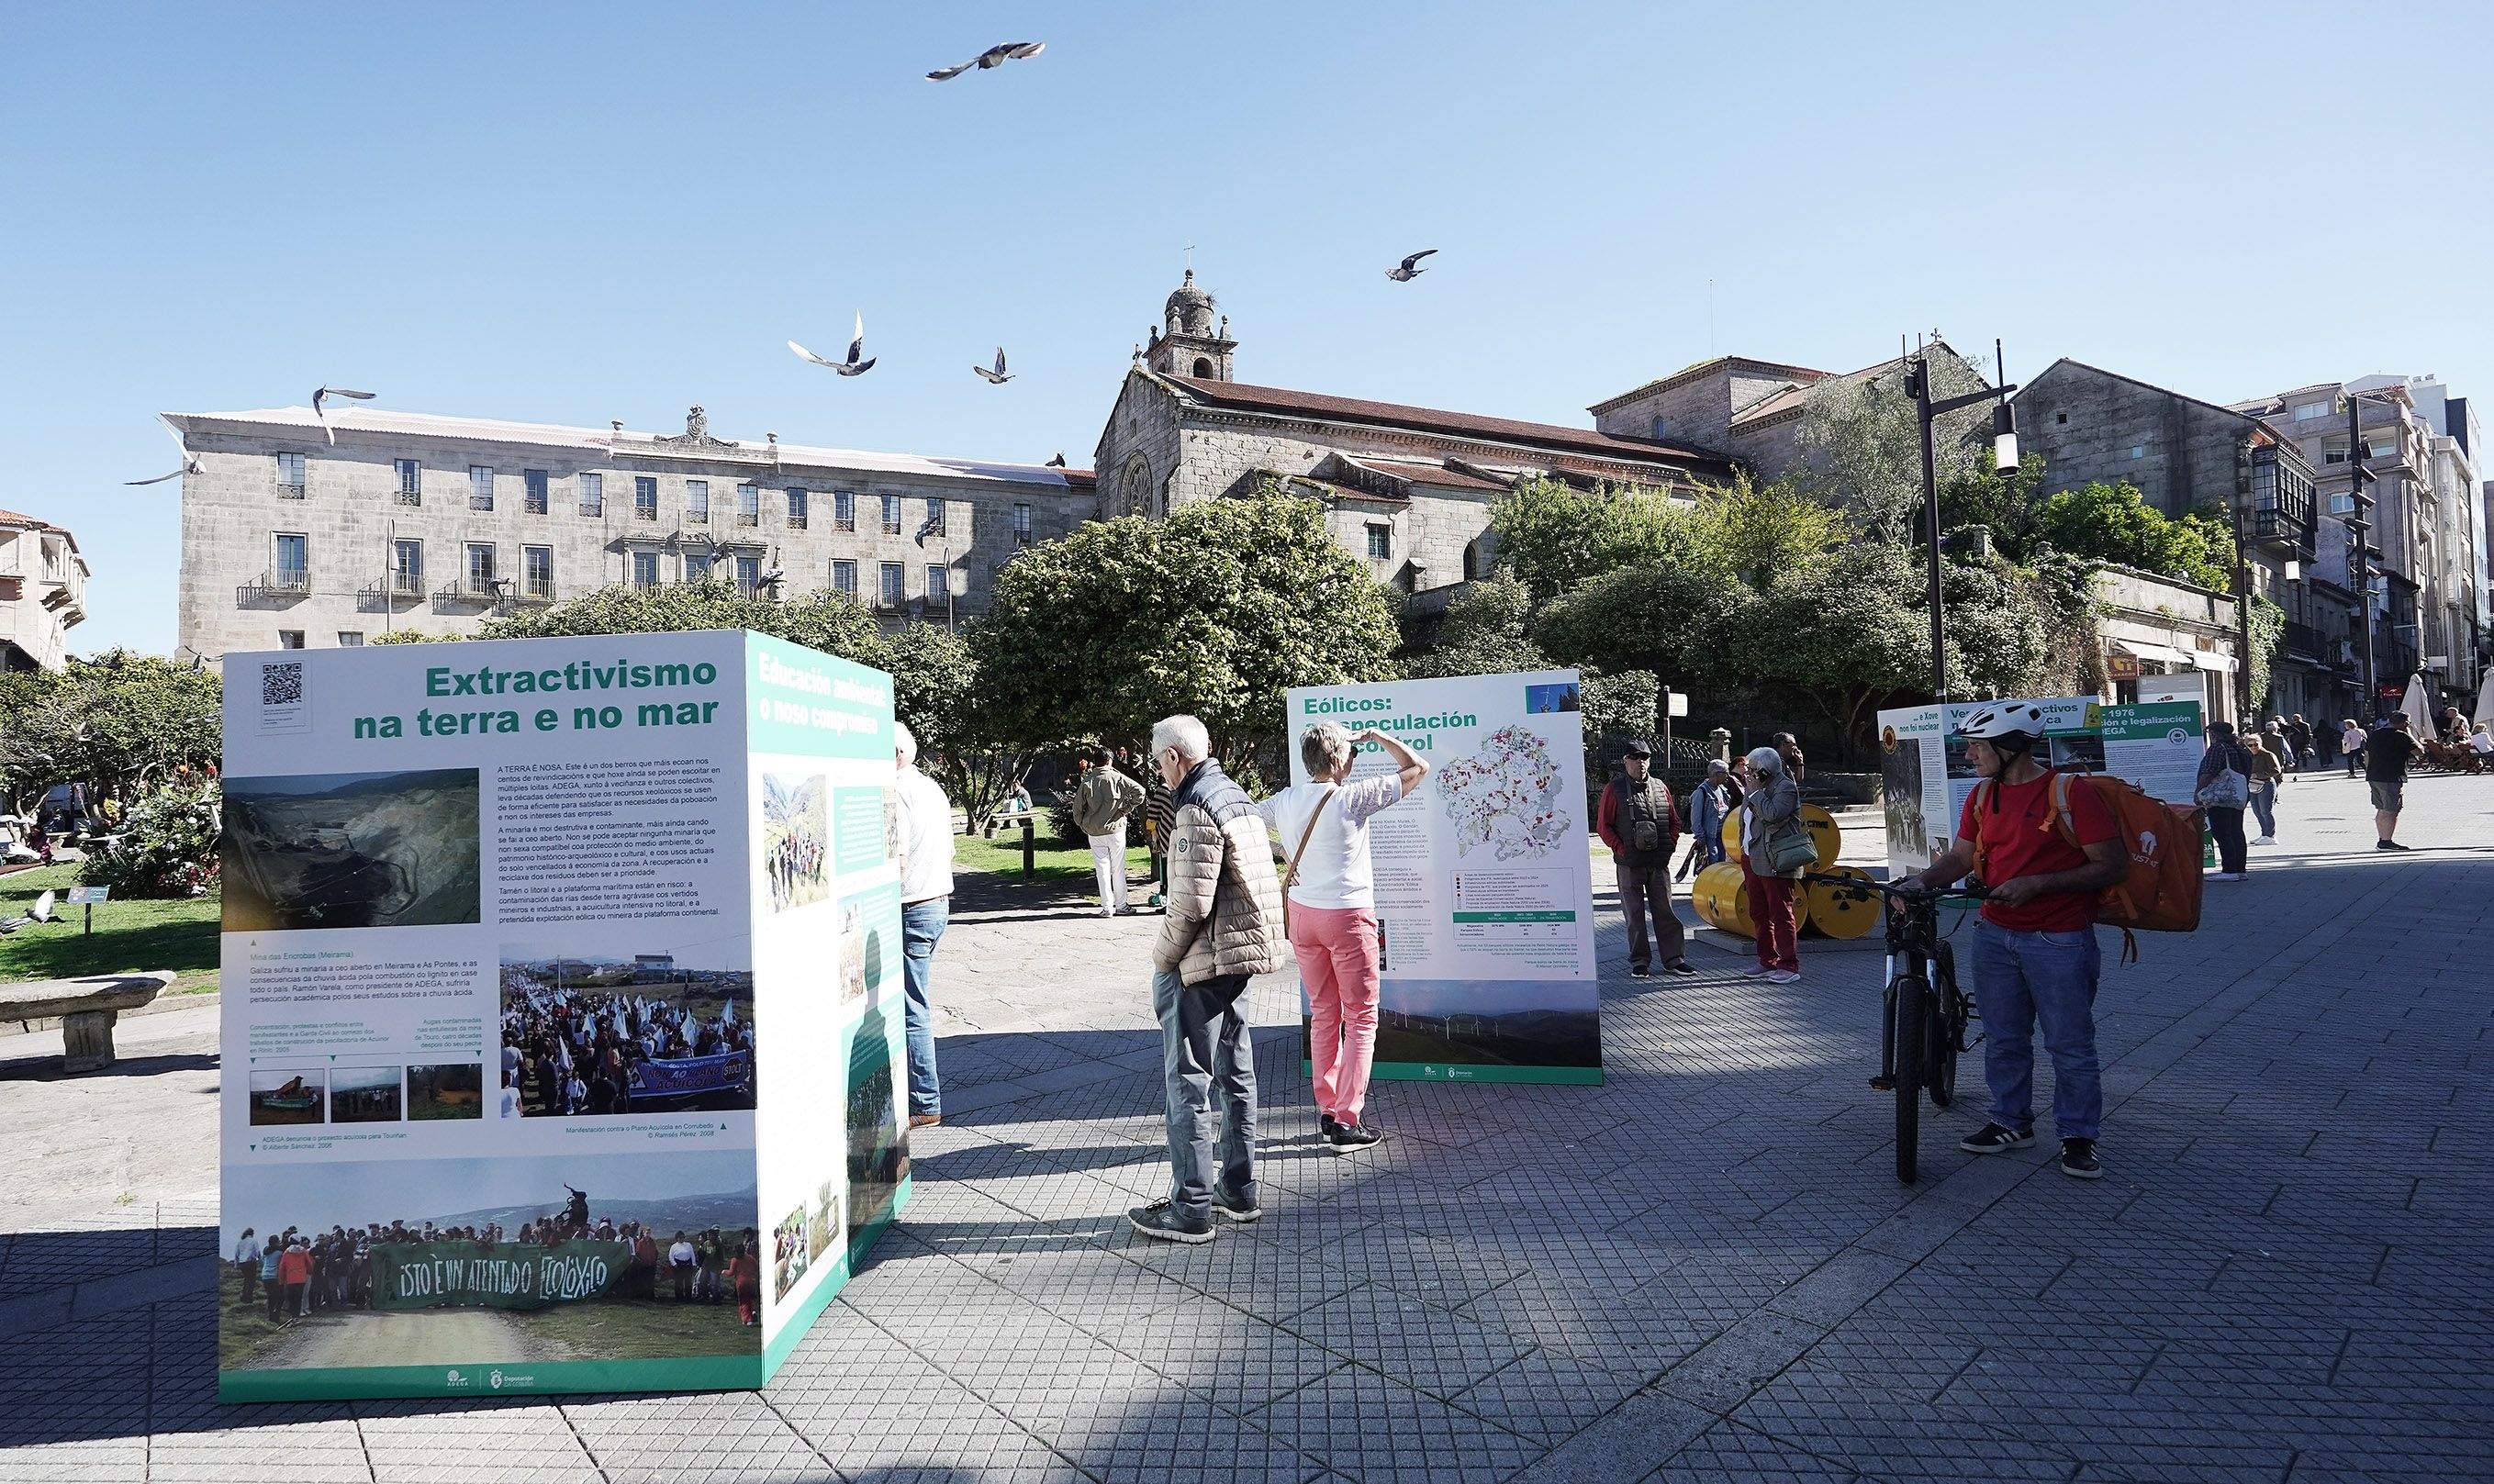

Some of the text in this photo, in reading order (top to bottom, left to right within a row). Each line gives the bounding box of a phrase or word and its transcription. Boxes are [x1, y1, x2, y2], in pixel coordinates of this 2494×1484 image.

[426, 659, 717, 697] Extractivismo
[758, 651, 832, 696] Educación
[1304, 697, 1392, 714] Eólicos:
[354, 701, 719, 739] na terra e no mar
[760, 697, 878, 738] o noso compromiso
[1924, 712, 1939, 720] Xove
[2108, 709, 2135, 718] 1976
[2131, 715, 2191, 726] legalización
[1918, 722, 1940, 731] nuclear
[2102, 727, 2127, 735] EGA
[503, 764, 531, 773] TERRA
[565, 762, 581, 770] Este
[638, 761, 653, 769] que
[653, 758, 671, 766] máis
[521, 774, 532, 782] de
[591, 772, 606, 780] que
[606, 769, 625, 777] hoxe
[625, 768, 646, 777] aínda
[657, 767, 680, 777] poden
[583, 780, 603, 788] xunto
[498, 793, 512, 801] leva
[513, 792, 543, 800] décadas
[544, 790, 587, 799] defendendo
[587, 791, 601, 799] que
[498, 803, 508, 811] de
[508, 802, 529, 810] forma
[530, 801, 560, 809] eficiente
[560, 802, 576, 810] para
[623, 797, 668, 805] necesidades
[669, 796, 679, 804] da
[680, 795, 718, 805] poboación
[529, 810, 562, 819] intereses
[563, 809, 576, 818] das
[504, 825, 531, 833] minaría
[553, 822, 587, 831] destrutiva
[646, 820, 664, 828] máis
[665, 819, 686, 827] aínda
[686, 817, 710, 826] cando
[585, 841, 622, 851] protección
[634, 839, 656, 847] medio
[498, 854, 535, 864] patrimonio
[688, 846, 713, 854] actuais
[498, 895, 549, 904] contaminación
[550, 894, 564, 902] das
[579, 892, 602, 901] desde
[603, 892, 620, 900] terra
[621, 891, 654, 901] agrávase
[498, 915, 534, 925] pretendida
[535, 913, 574, 923] explotación
[632, 909, 643, 918] da
[643, 909, 680, 919] plataforma
[267, 952, 282, 960] das
[282, 951, 317, 959] Encrobas
[672, 1070, 688, 1078] AO
[446, 1259, 464, 1291] UN
[468, 1259, 532, 1294] ATENTADO
